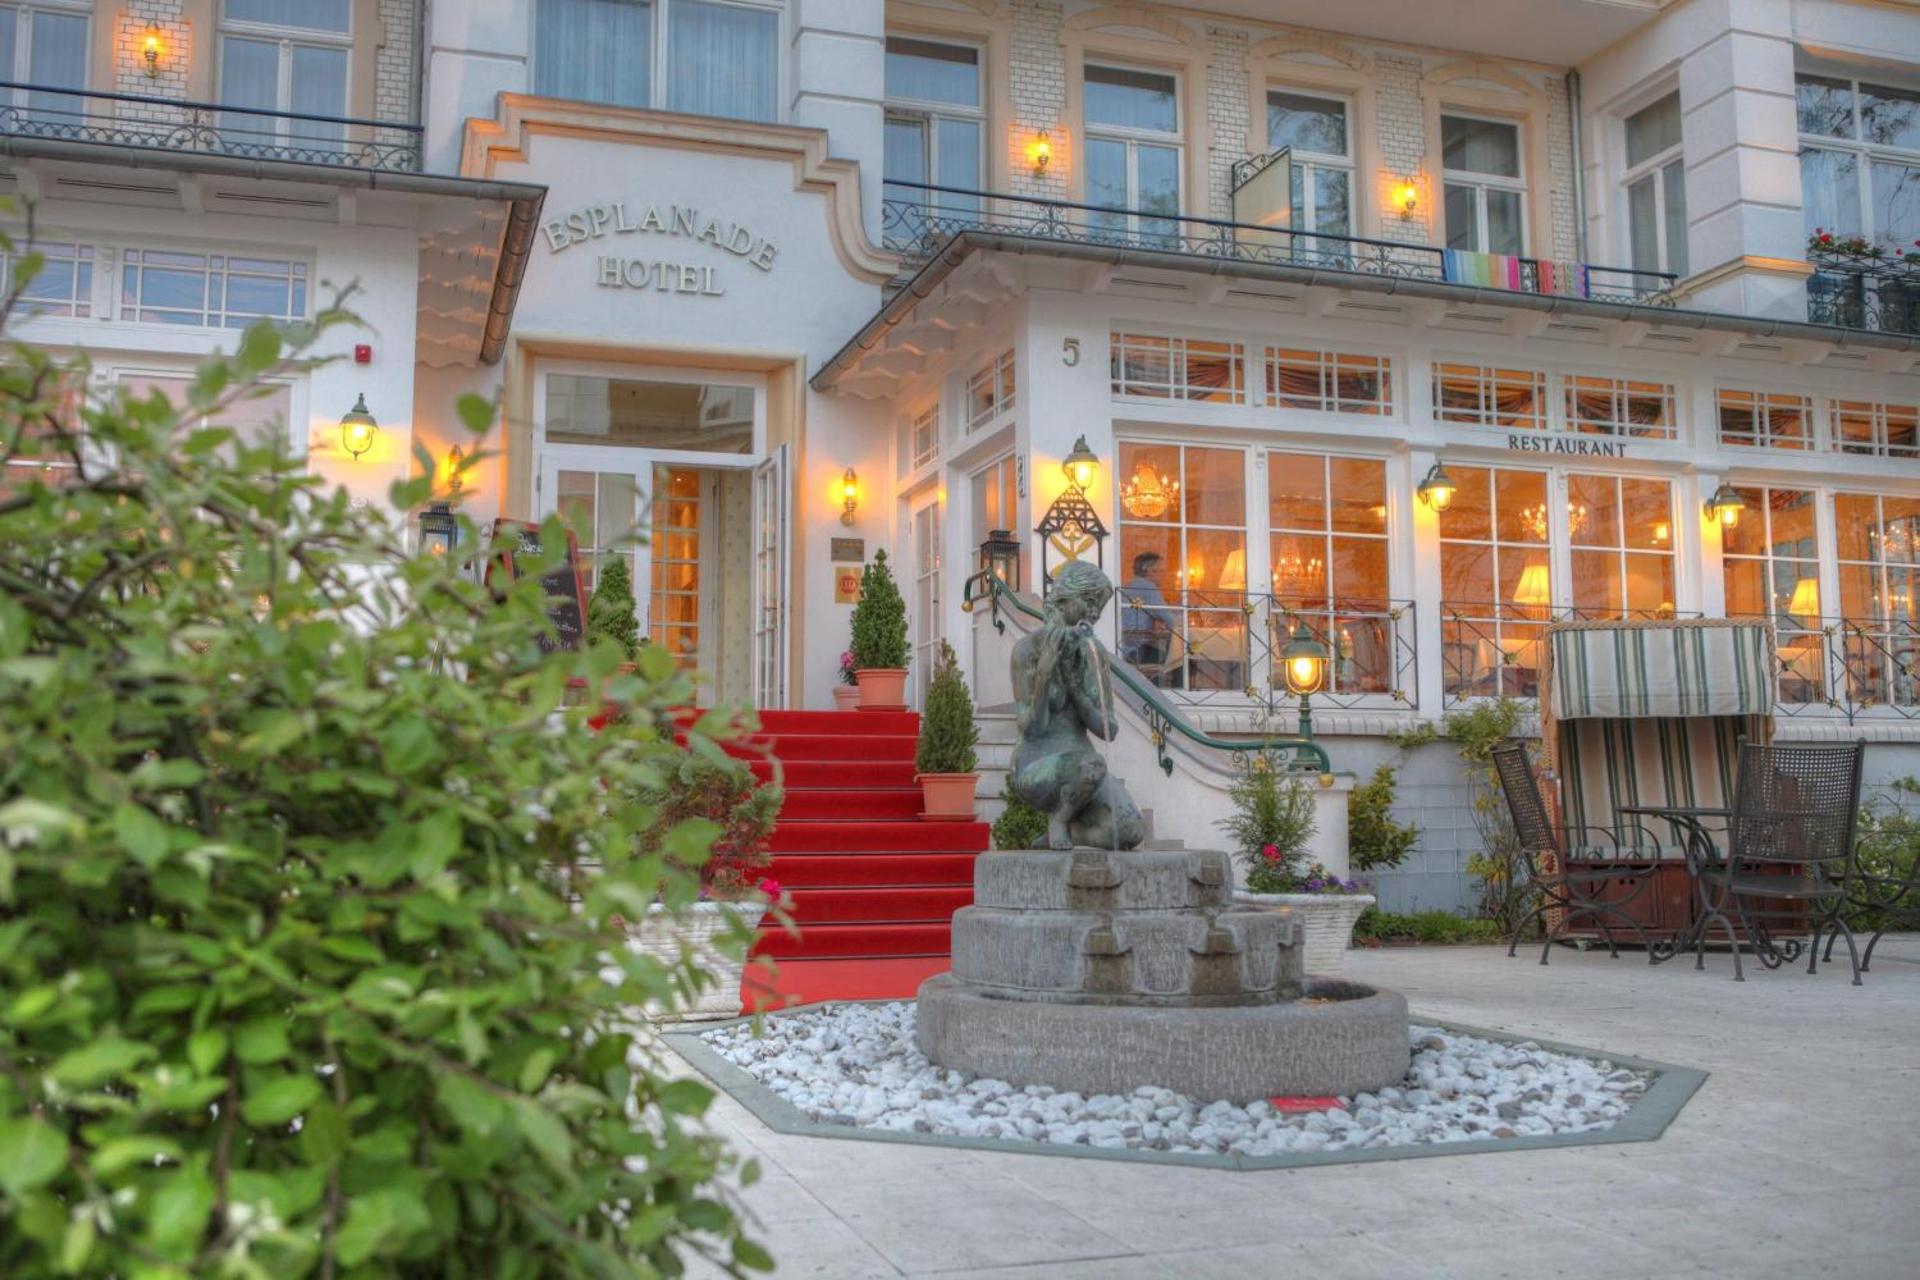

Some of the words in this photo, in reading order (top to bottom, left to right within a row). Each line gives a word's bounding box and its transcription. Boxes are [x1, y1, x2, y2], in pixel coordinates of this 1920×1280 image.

[543, 203, 779, 272] ESPLANADE
[597, 256, 725, 295] HOTEL
[1062, 337, 1080, 368] 5
[1508, 435, 1627, 458] RESTAURANT
